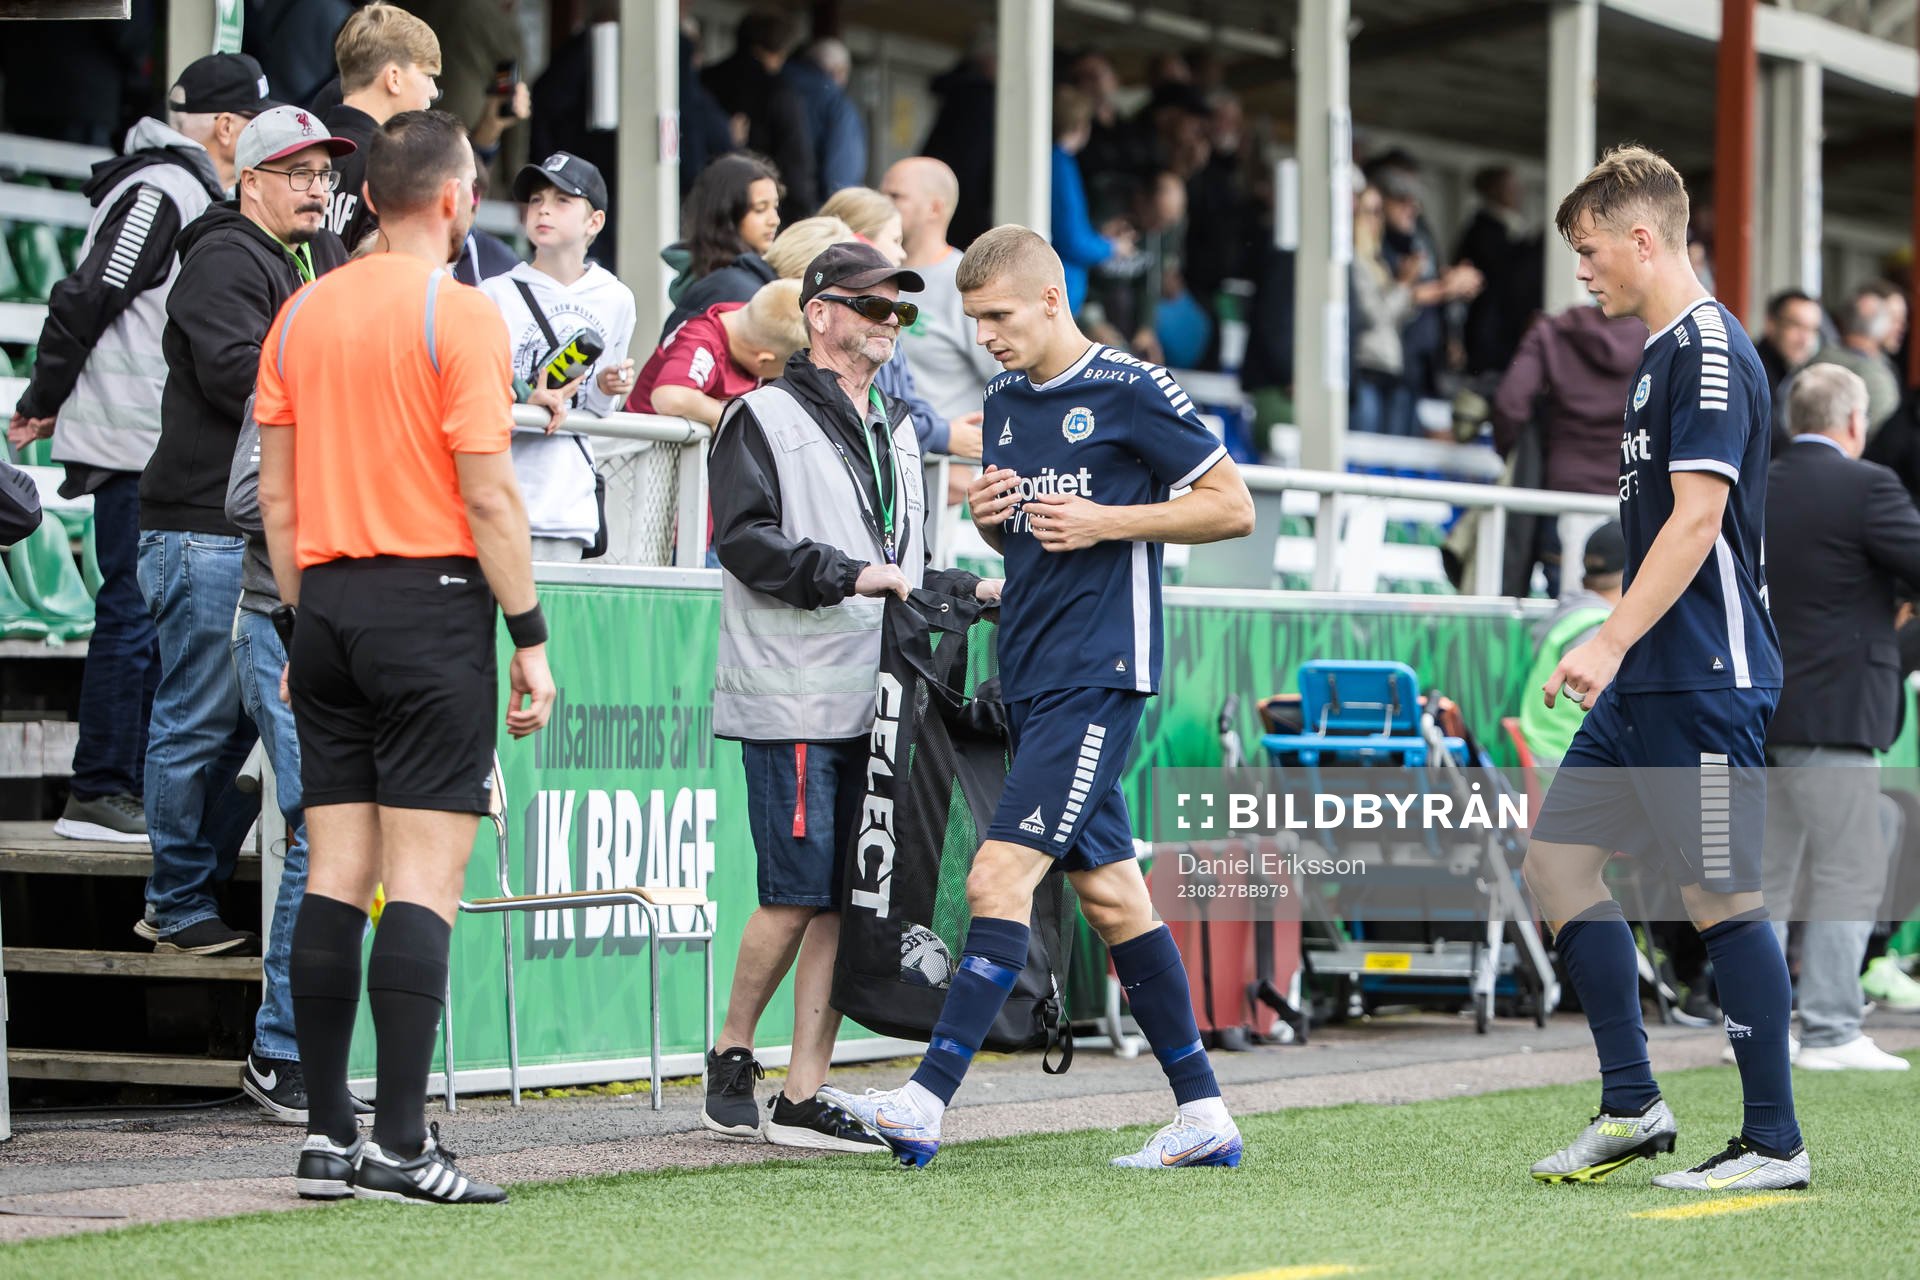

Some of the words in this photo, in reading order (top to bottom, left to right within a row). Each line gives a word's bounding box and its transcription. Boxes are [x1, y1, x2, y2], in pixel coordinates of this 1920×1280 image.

[1083, 367, 1141, 385] BRIXLY
[670, 683, 694, 769] är
[852, 672, 903, 918] SELECT
[1019, 821, 1046, 836] SELECT
[534, 789, 576, 941] IK
[584, 787, 718, 939] BRAGE
